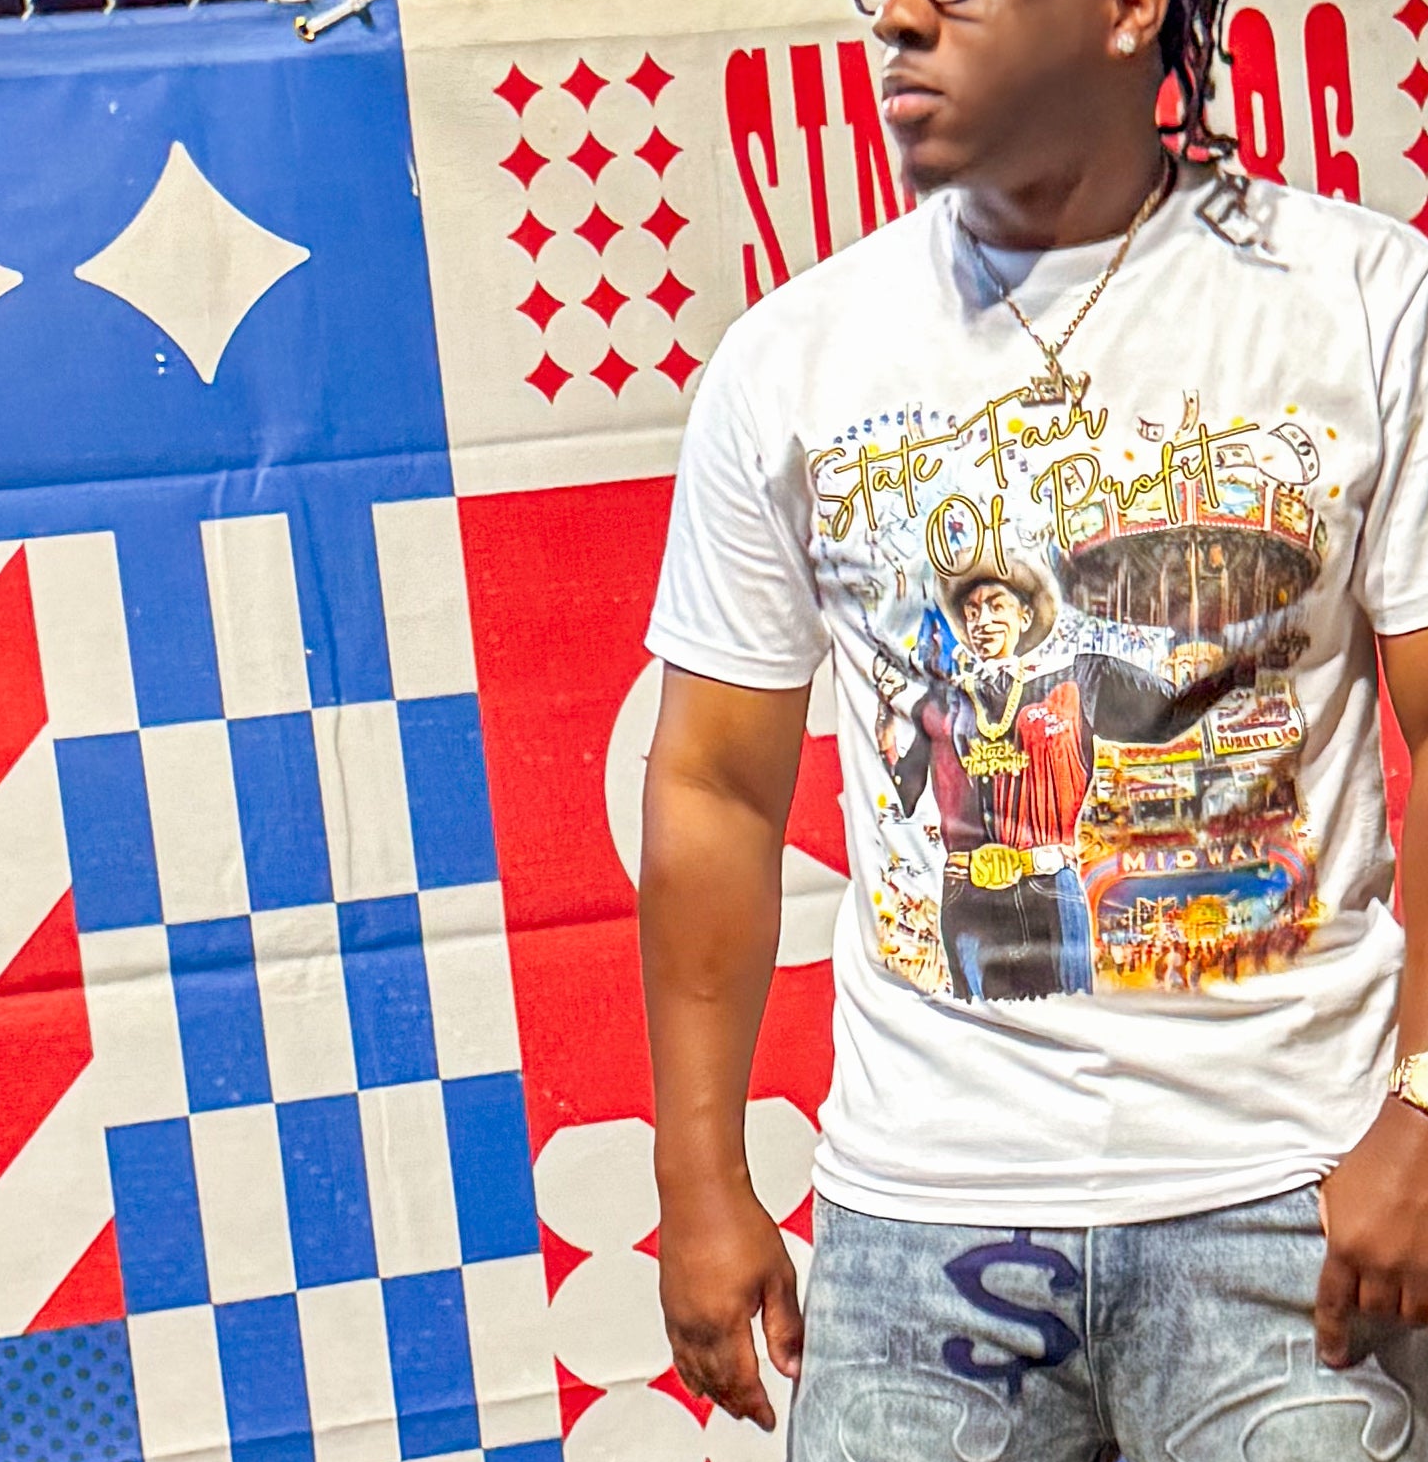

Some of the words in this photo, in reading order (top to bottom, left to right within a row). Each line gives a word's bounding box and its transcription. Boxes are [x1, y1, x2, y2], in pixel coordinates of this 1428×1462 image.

[724, 40, 916, 309] SIN
[809, 433, 952, 542] State
[956, 387, 1109, 489] Fair
[926, 494, 1009, 577] Of
[1031, 424, 1260, 549] Profit
[969, 738, 1015, 760] Stack
[1123, 836, 1264, 872] MIDWAY
